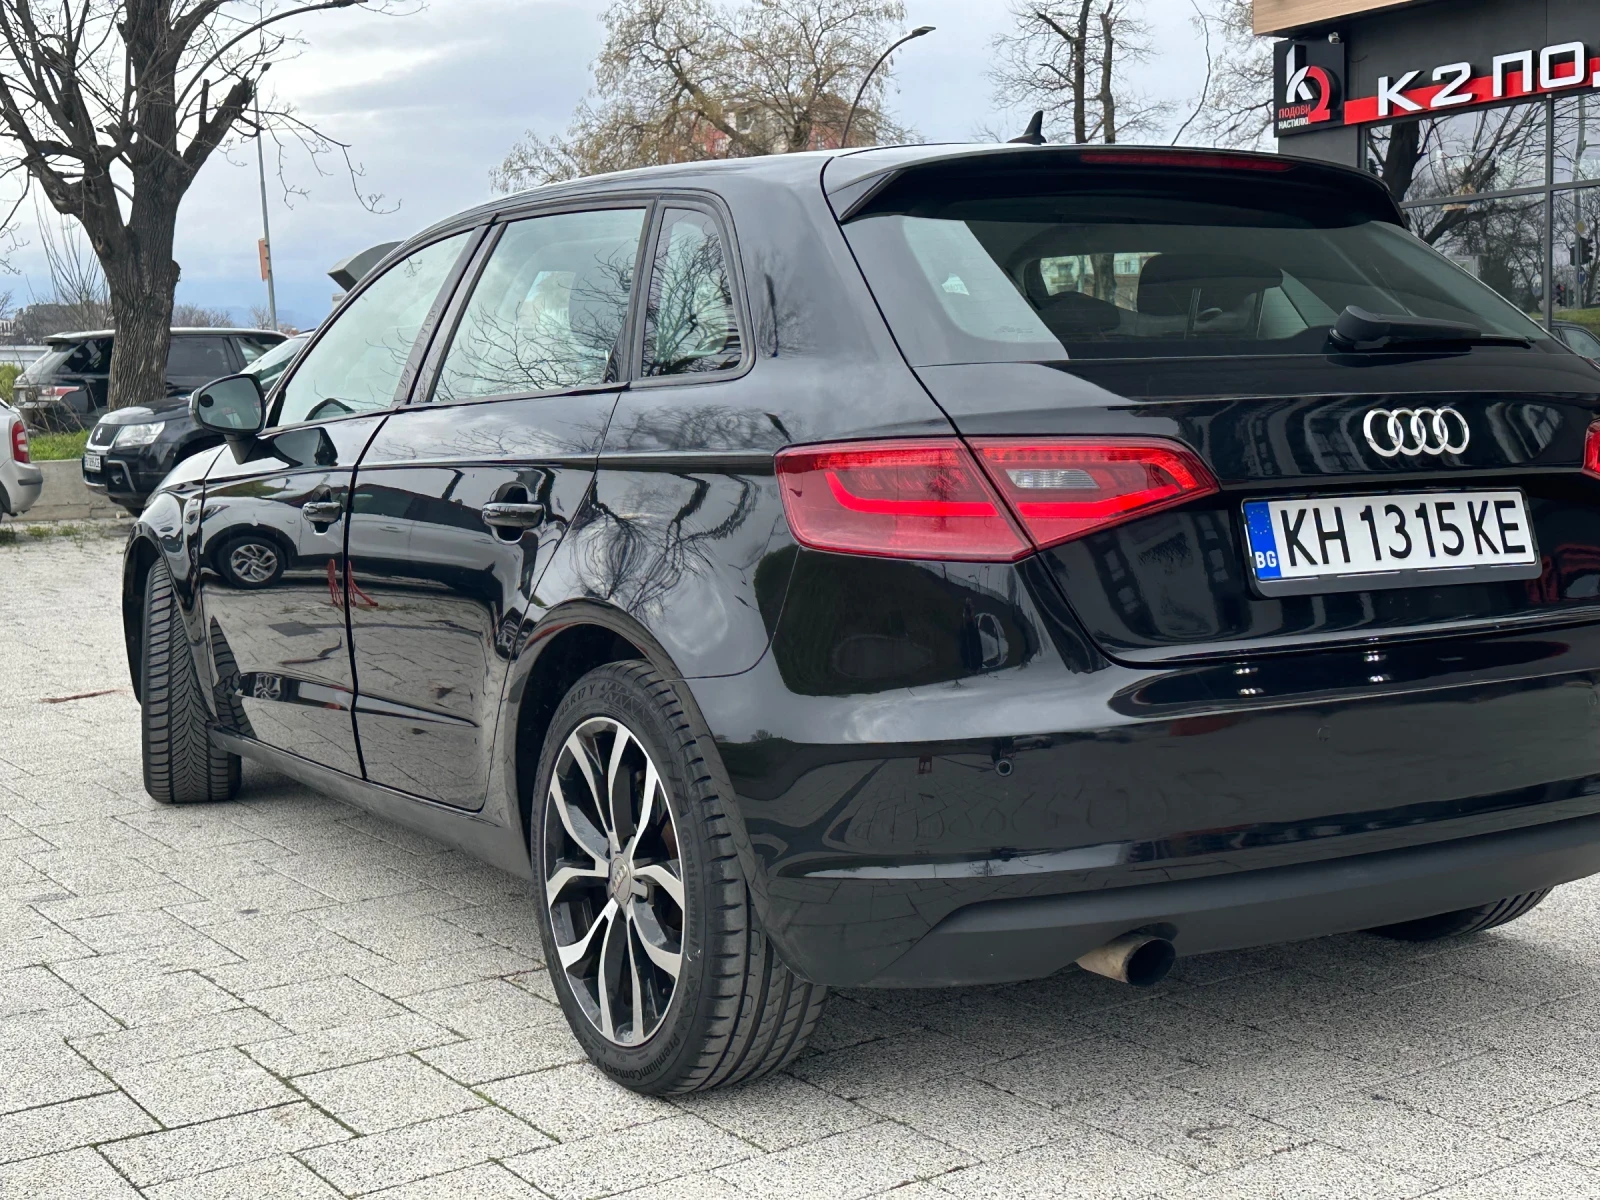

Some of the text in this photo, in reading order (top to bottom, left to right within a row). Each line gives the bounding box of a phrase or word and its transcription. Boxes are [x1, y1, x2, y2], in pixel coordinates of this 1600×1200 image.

[1278, 104, 1311, 119] ПОДОВИ
[1254, 550, 1278, 569] BG
[681, 827, 700, 947] Continental
[603, 1032, 681, 1081] PremiumContact
